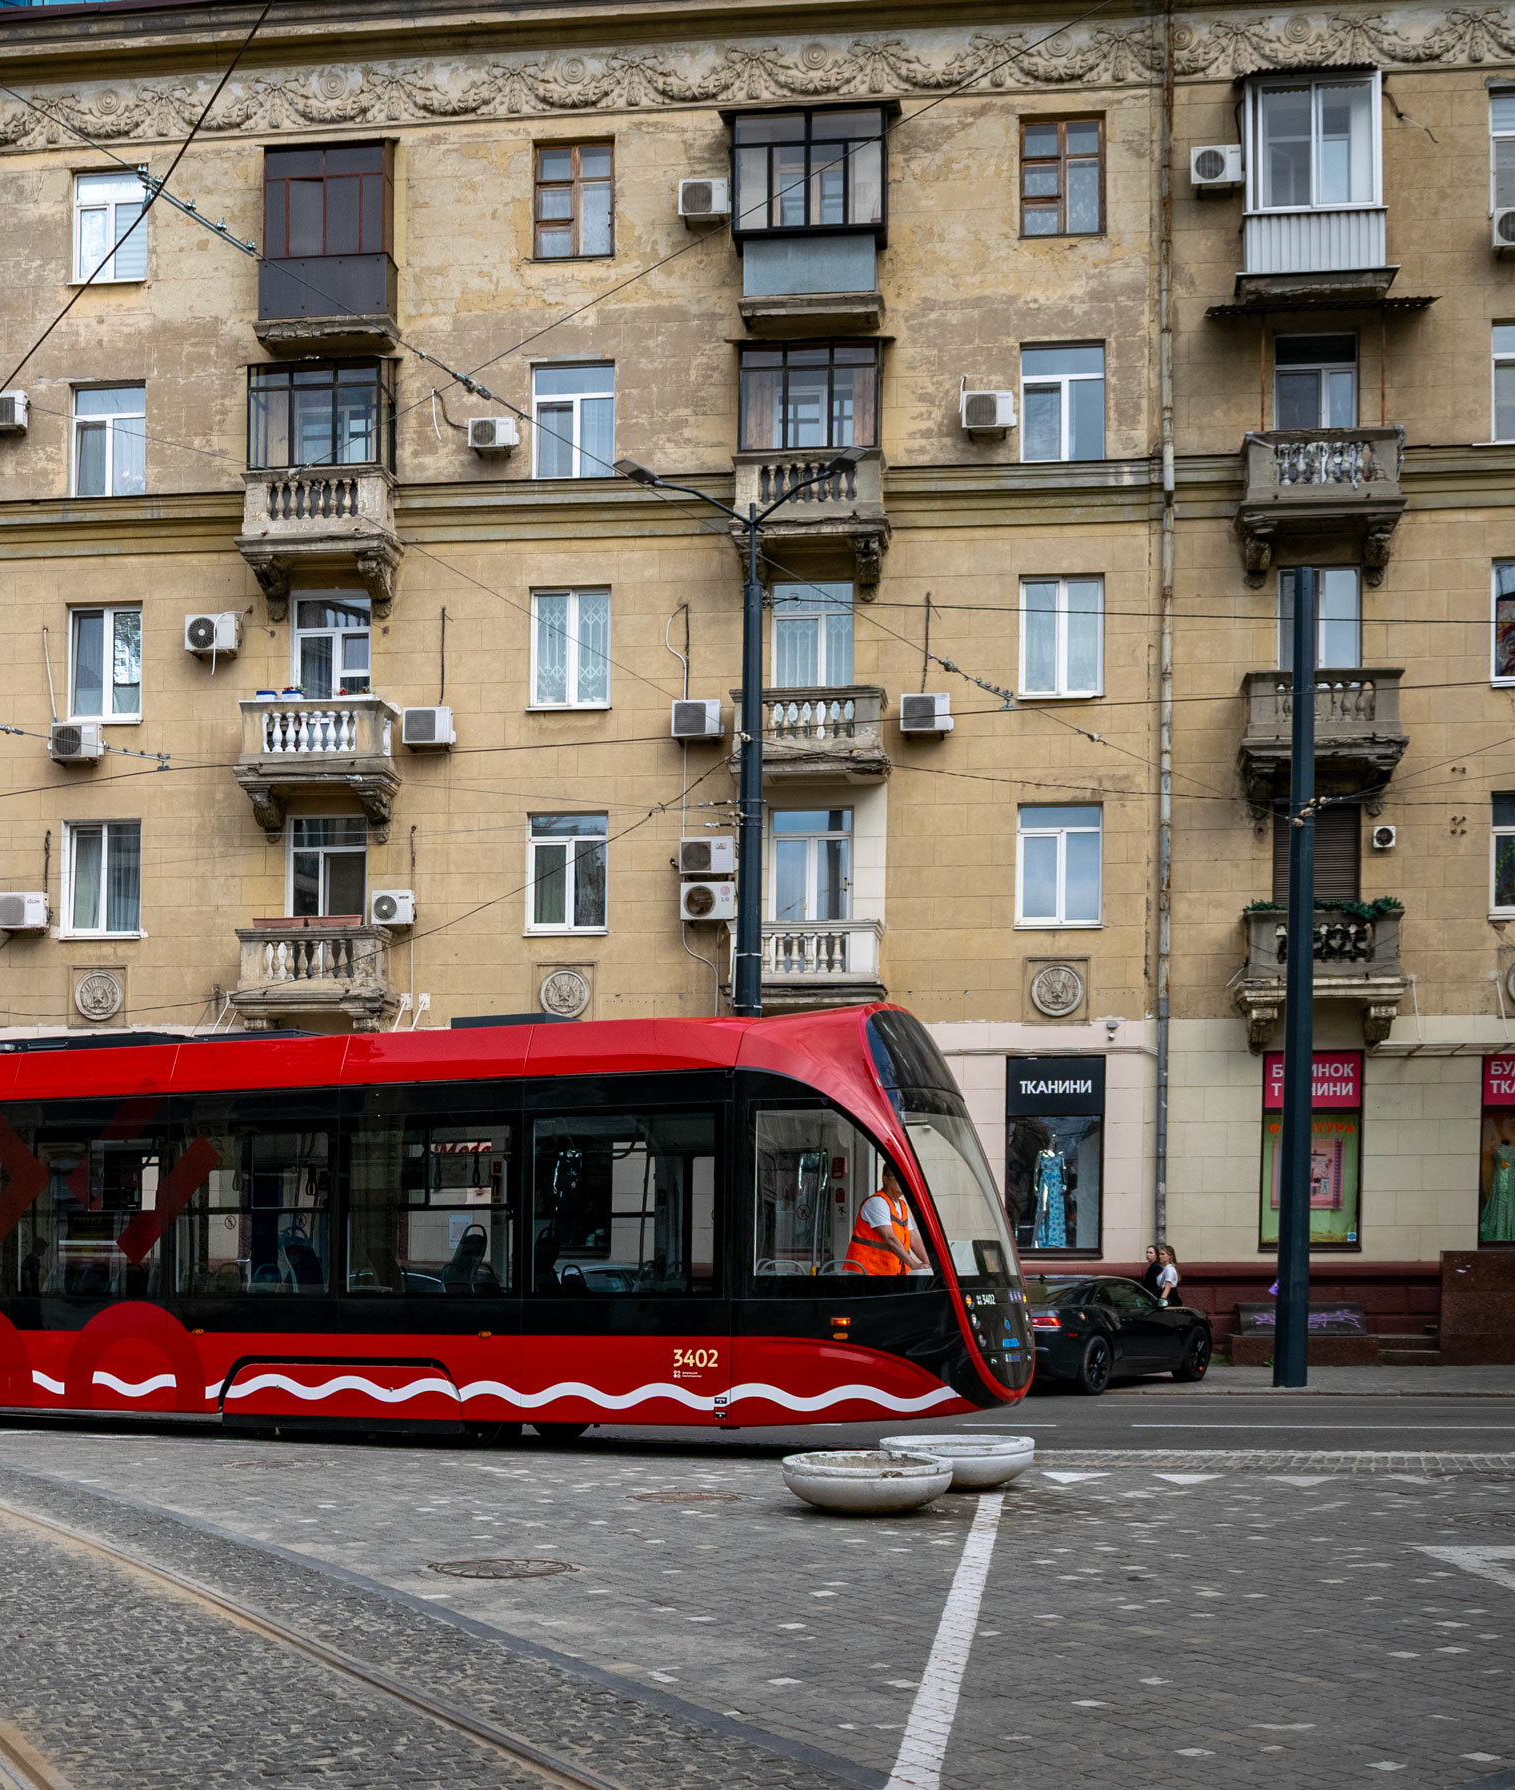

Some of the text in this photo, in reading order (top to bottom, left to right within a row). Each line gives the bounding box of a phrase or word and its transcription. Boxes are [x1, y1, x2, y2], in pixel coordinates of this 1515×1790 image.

[1490, 1061, 1515, 1077] БУ
[1019, 1079, 1092, 1094] ТКАНИНИ
[981, 1293, 996, 1305] 3402
[673, 1349, 718, 1367] 3402
